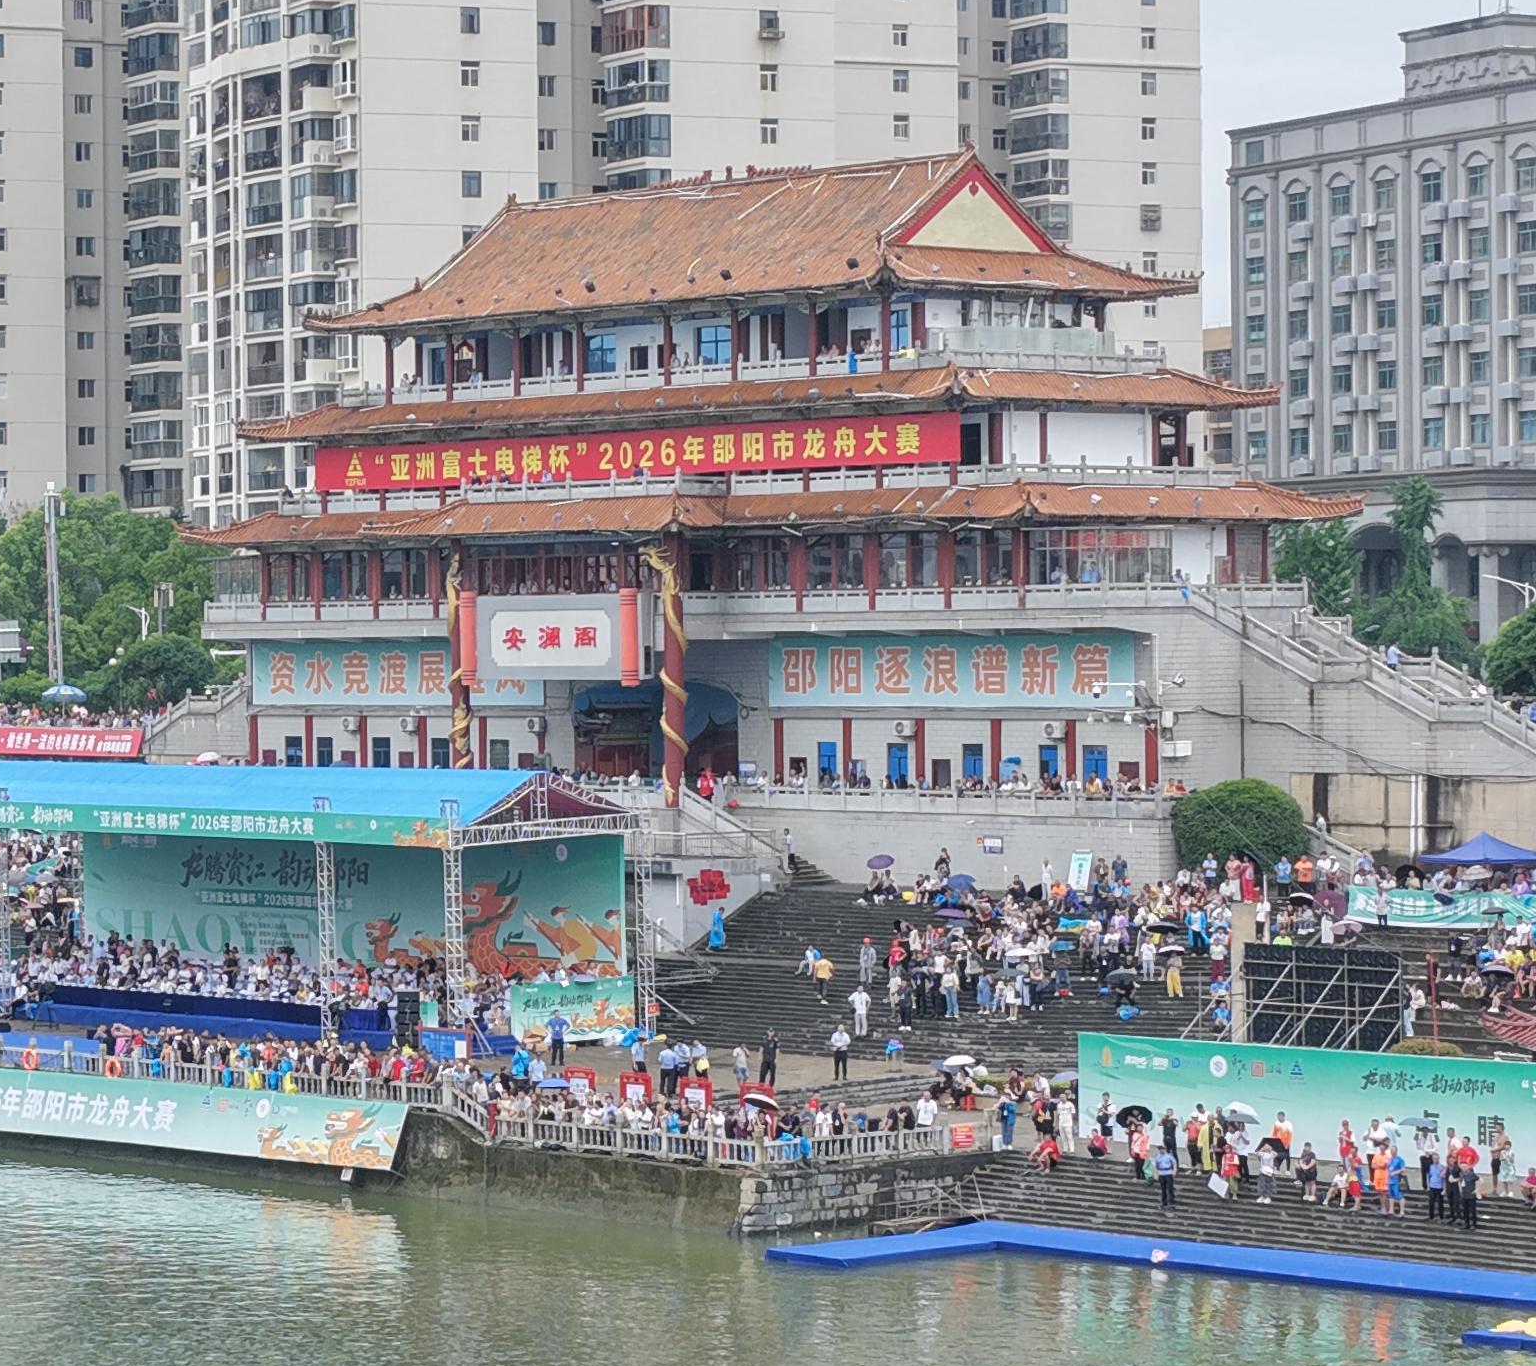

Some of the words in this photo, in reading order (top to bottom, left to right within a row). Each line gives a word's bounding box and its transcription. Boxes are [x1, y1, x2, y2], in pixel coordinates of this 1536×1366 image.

[270, 651, 527, 696] 资水竞渡展
[782, 643, 1111, 696] 邵阳逐浪谱新篇
